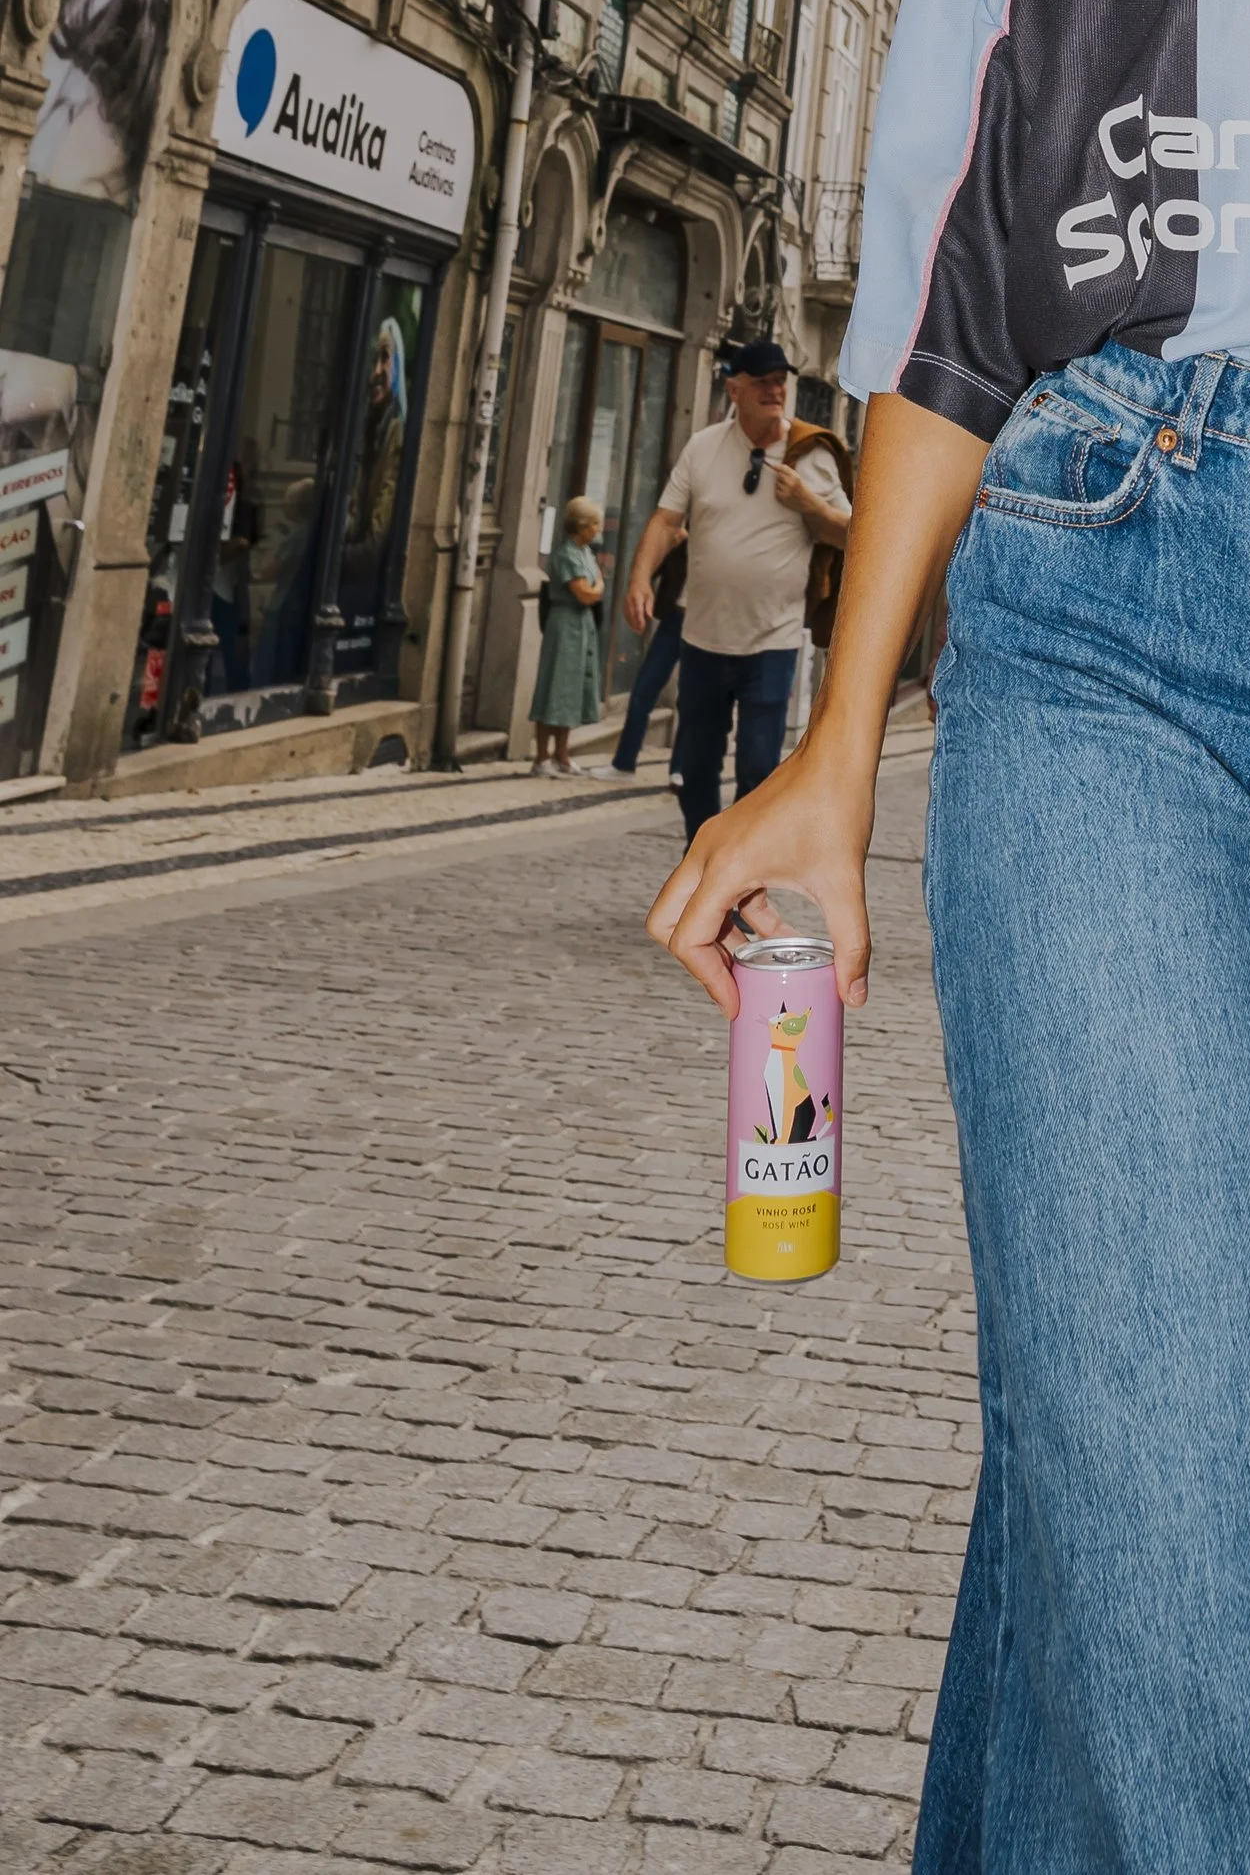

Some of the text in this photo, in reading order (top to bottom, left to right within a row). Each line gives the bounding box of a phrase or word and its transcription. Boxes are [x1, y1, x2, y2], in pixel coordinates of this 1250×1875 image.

[272, 72, 388, 172] Audika
[418, 129, 457, 165] Centros
[745, 1153, 829, 1181] GATÃO
[756, 1203, 817, 1217] VINHO ROSÉ
[789, 1219, 811, 1229] WINE
